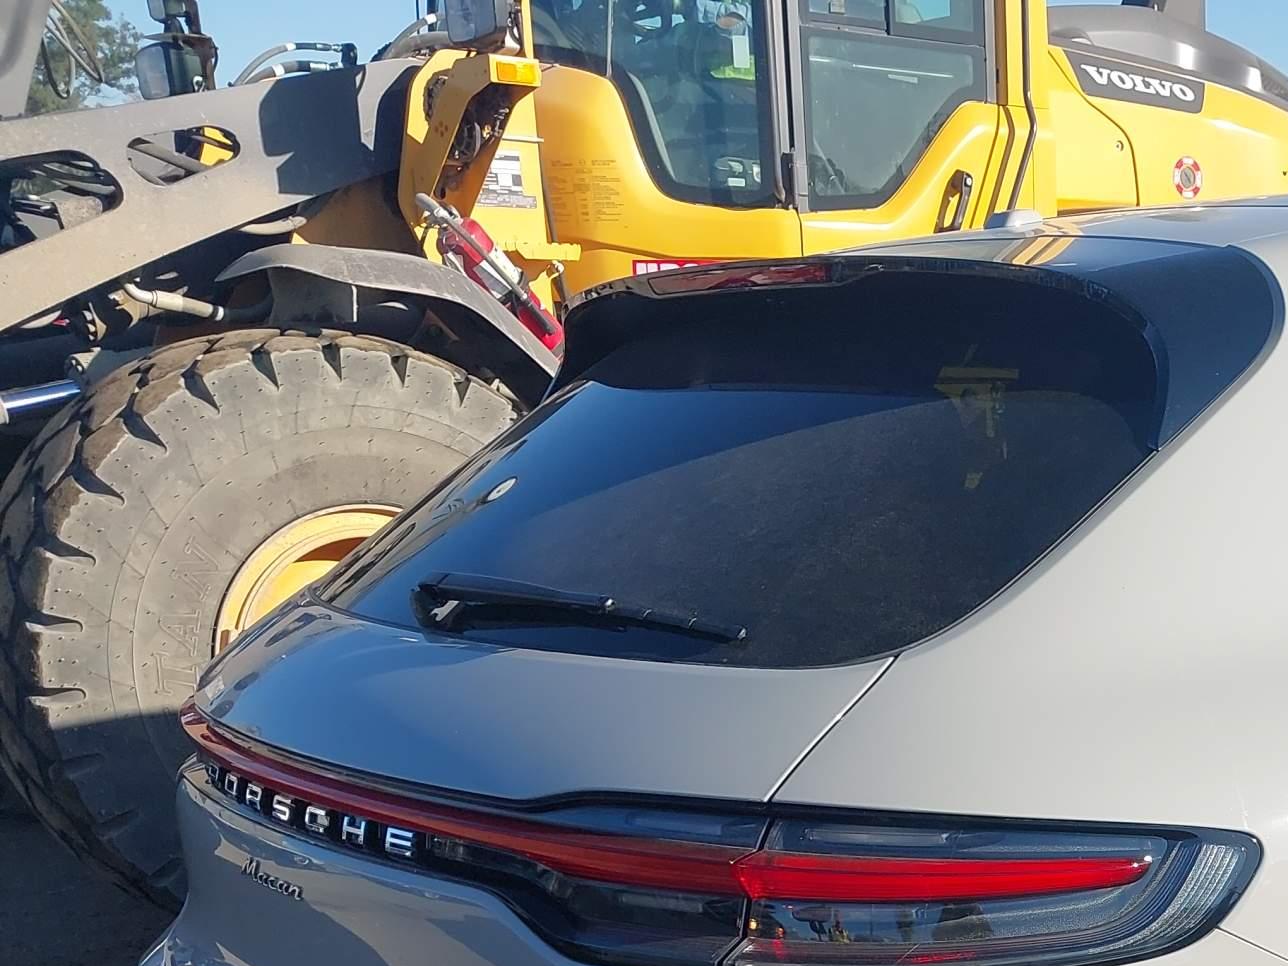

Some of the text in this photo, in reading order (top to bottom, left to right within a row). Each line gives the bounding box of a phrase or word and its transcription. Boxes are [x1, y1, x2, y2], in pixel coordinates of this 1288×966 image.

[1080, 64, 1195, 101] VOLVO
[207, 762, 416, 857] PORSCHE
[241, 857, 304, 900] Macan
